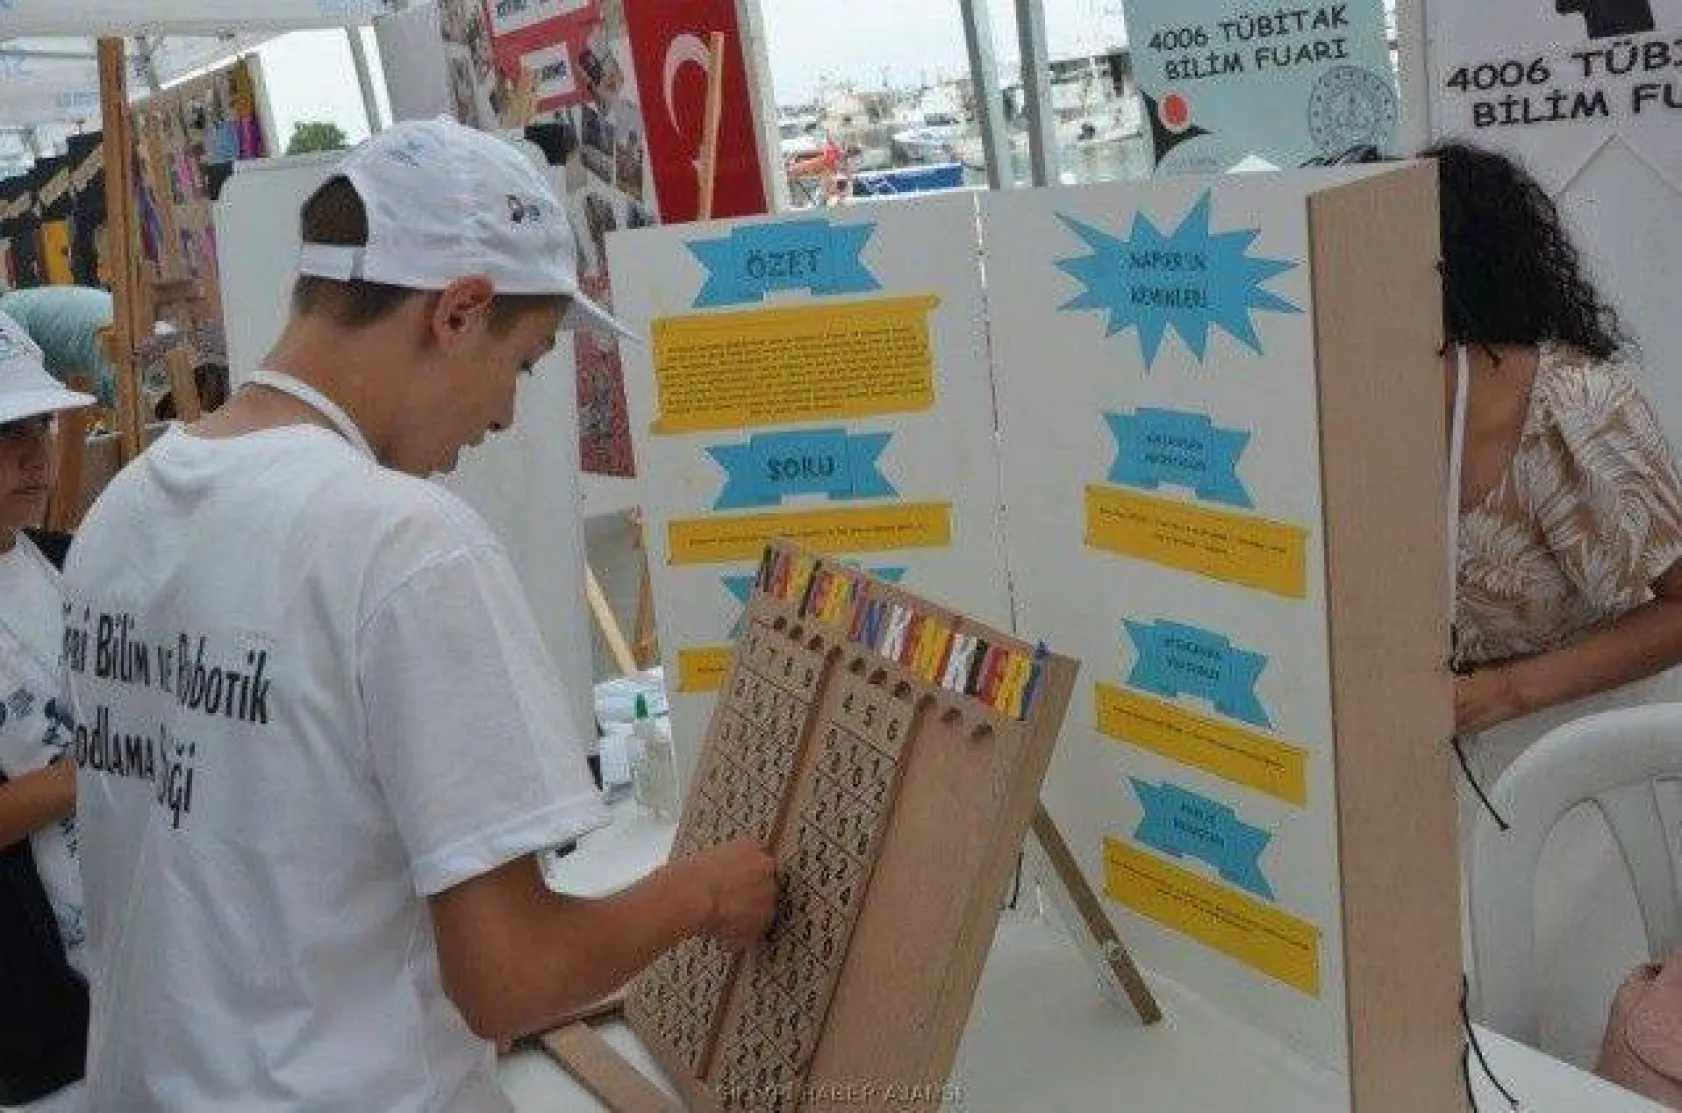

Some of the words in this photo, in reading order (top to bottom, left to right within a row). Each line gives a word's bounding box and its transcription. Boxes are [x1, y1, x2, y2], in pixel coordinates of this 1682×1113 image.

[1149, 26, 1209, 53] 4006
[1216, 4, 1350, 43] TÜBİTAK
[1164, 51, 1244, 80] BİLİM
[1254, 38, 1350, 71] FUARI
[1447, 56, 1551, 92] 4006
[1473, 88, 1609, 127] BİLİM
[747, 246, 822, 280] ÖZET
[767, 454, 835, 482] SORU
[74, 704, 158, 783] odlama
